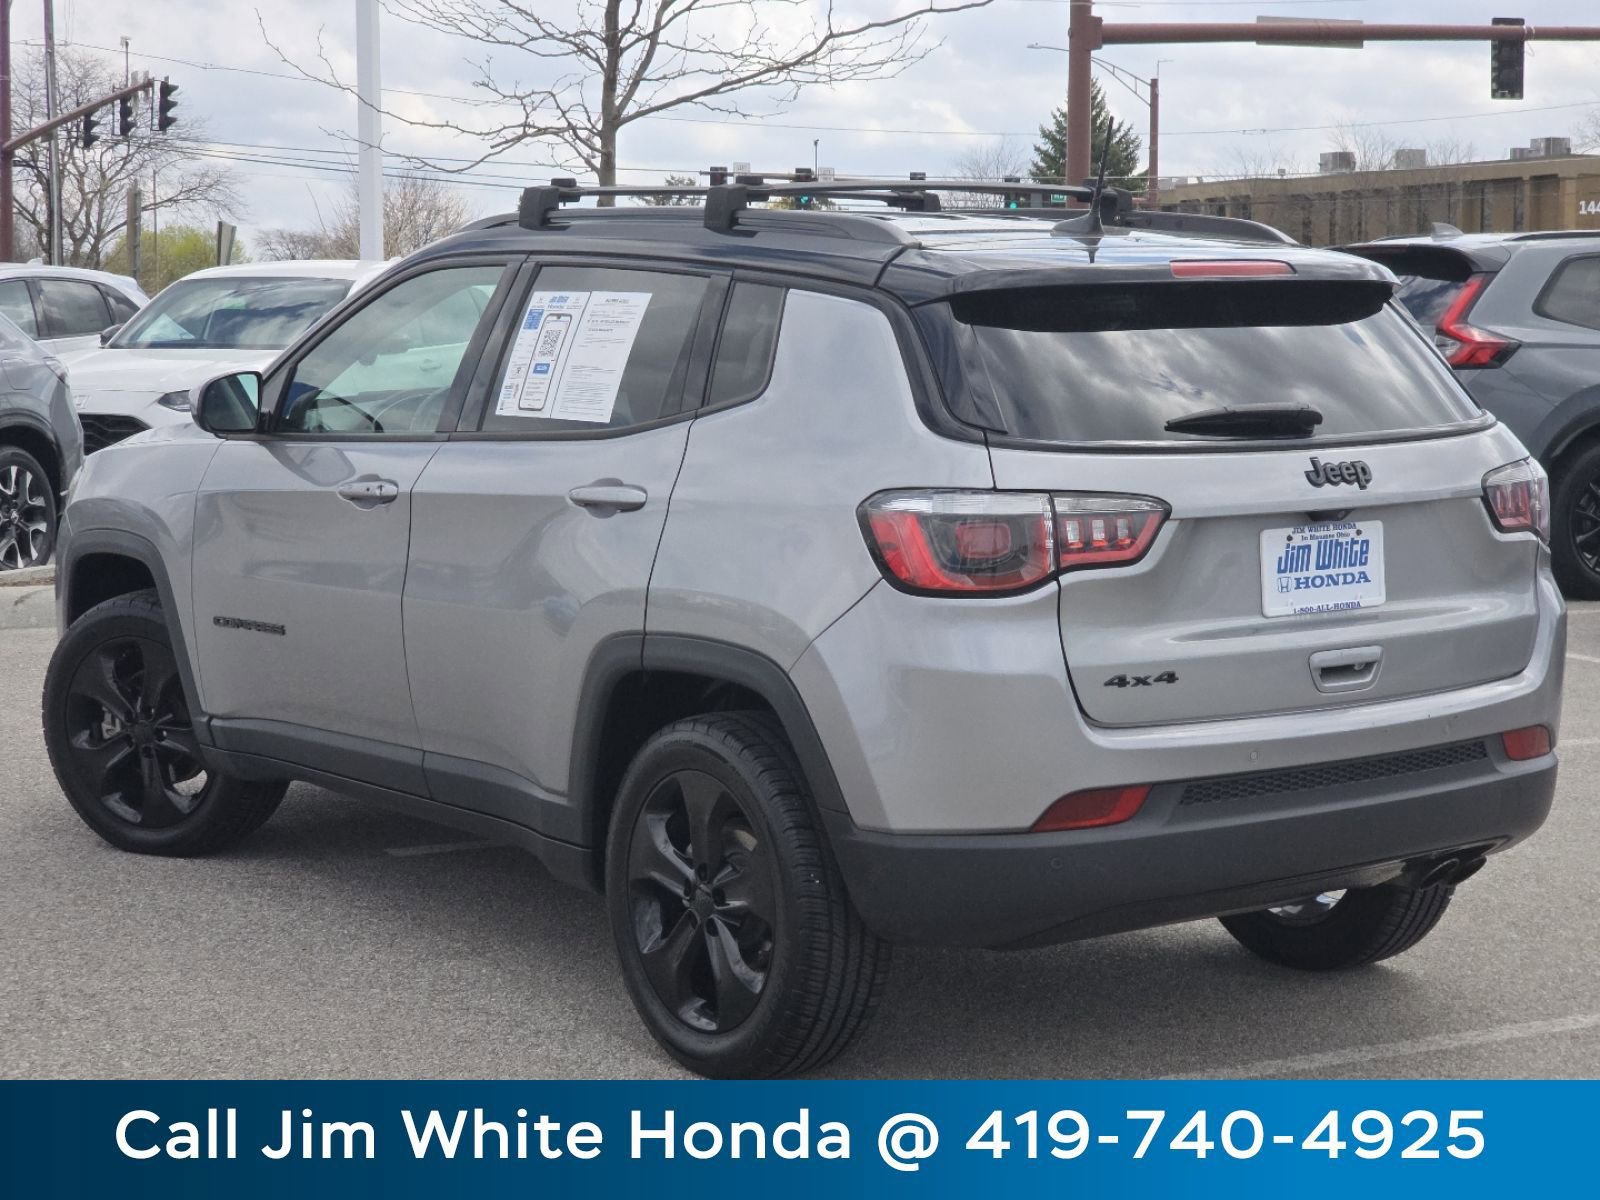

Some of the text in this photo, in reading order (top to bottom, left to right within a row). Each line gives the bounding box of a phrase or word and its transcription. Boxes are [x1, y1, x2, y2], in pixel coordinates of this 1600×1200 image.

[1304, 456, 1373, 490] Jeep
[1308, 525, 1331, 533] WHITE
[1332, 522, 1357, 531] HONDA
[1315, 537, 1370, 571] White
[1294, 571, 1371, 590] HONDA
[1293, 601, 1361, 615] 1-800-ALL-HONDA
[1103, 670, 1179, 688] 4x4
